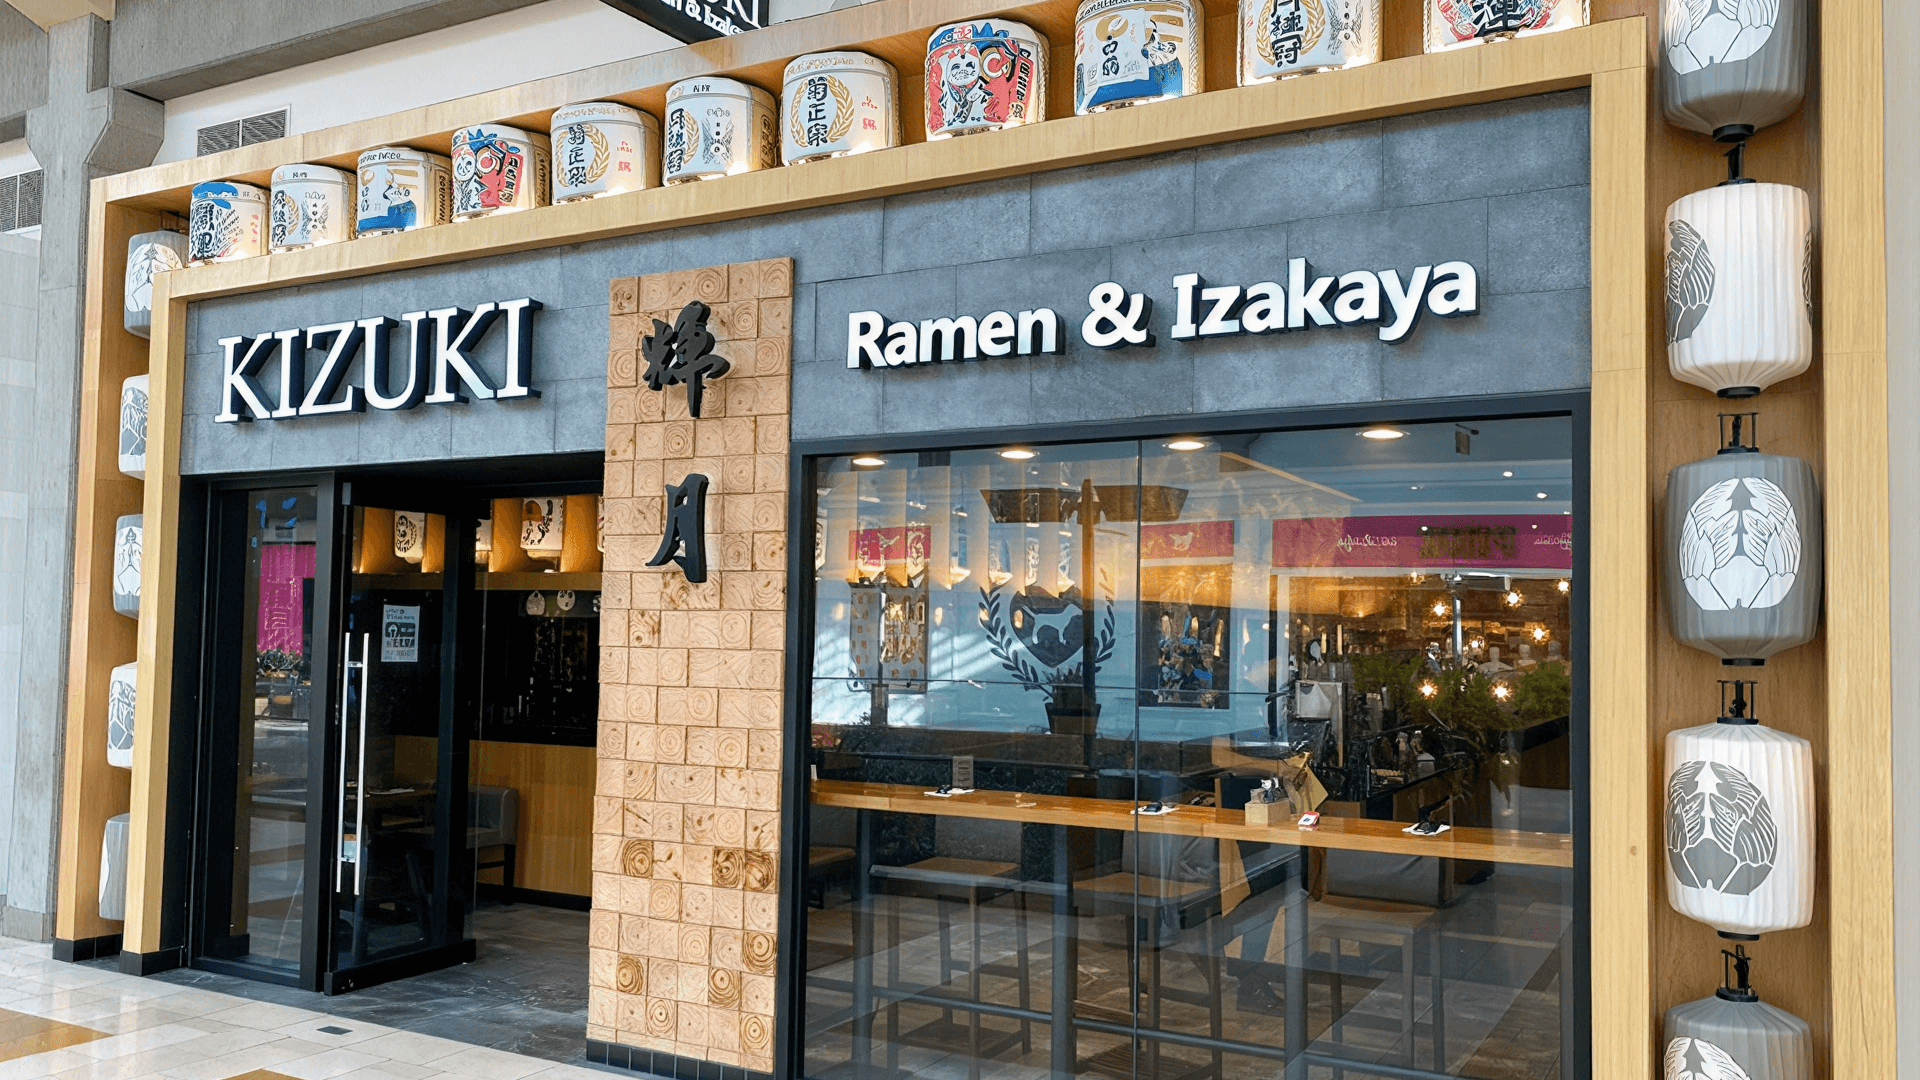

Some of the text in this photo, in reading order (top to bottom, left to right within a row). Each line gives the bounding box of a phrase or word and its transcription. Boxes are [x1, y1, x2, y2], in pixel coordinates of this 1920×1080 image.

[215, 297, 542, 424] KIZUKI
[846, 257, 1479, 370] Ramen & Izakaya
